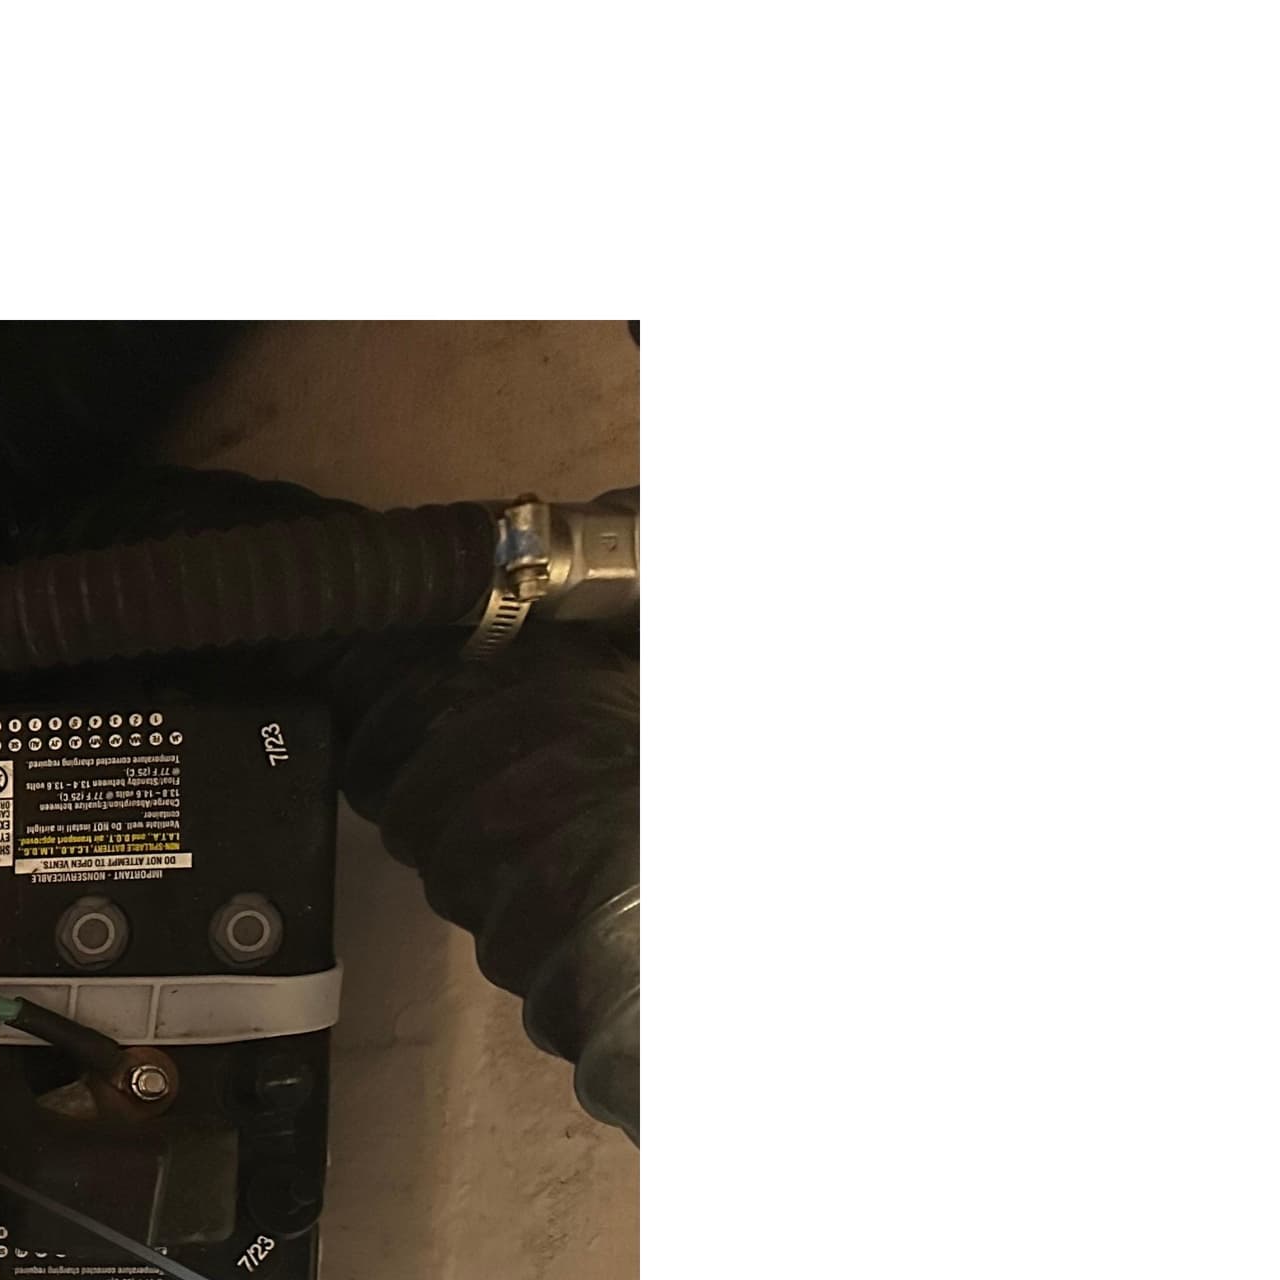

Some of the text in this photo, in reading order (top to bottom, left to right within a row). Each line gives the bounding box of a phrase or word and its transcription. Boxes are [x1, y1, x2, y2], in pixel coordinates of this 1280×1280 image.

[261, 722, 289, 767] 7/23
[71, 857, 162, 868] NOT ATTEMPT OPEN
[32, 870, 162, 883] IMPORTANT NONSERVICEABLE
[237, 1235, 274, 1272] 7/23
